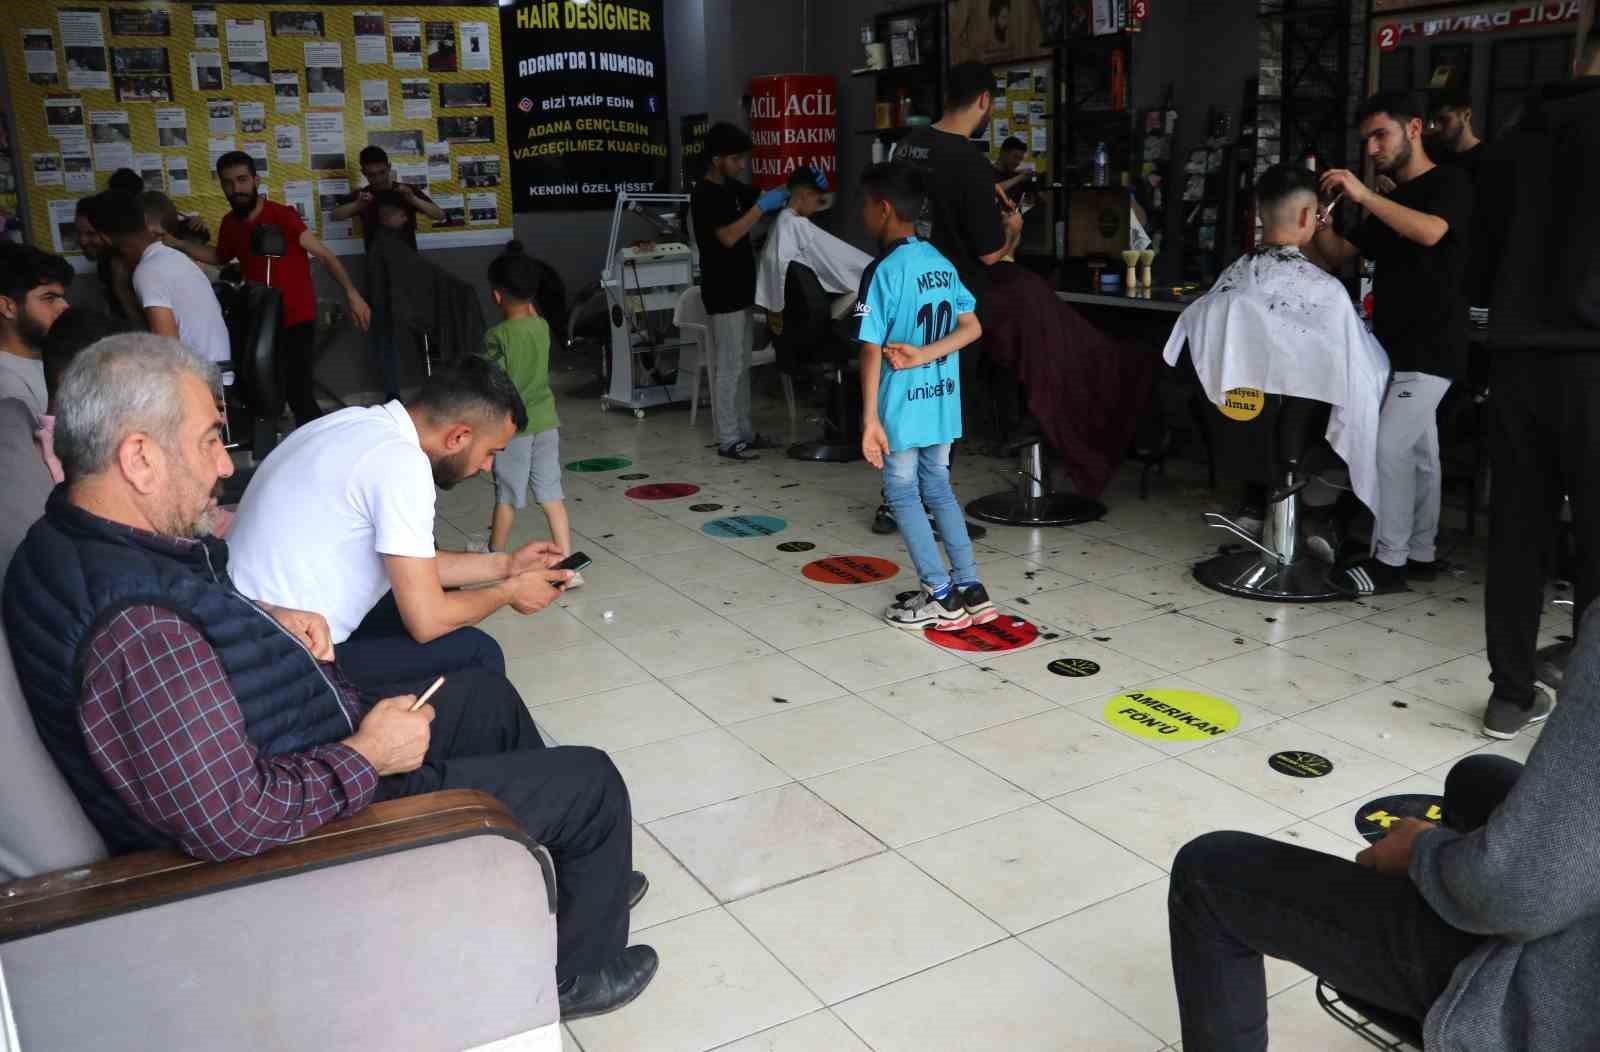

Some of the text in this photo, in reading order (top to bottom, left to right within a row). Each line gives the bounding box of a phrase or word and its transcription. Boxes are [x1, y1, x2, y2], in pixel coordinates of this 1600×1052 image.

[1136, 2, 1146, 19] 3
[1380, 28, 1394, 47] 2
[518, 51, 587, 78] ADANA'DA
[599, 52, 654, 78] NUMARA
[568, 93, 604, 108] TAKİP
[606, 95, 635, 110] EDİN
[784, 88, 837, 116] ACİL
[528, 120, 573, 139] ADANA
[784, 128, 838, 144] BAKIM
[581, 182, 612, 194] ÖZEL
[917, 270, 953, 294] MESSI
[916, 300, 953, 368] 10
[907, 378, 945, 401] unicef
[1118, 707, 1181, 735] FÖN'Ü
[1125, 692, 1227, 736] AMERİKAN
